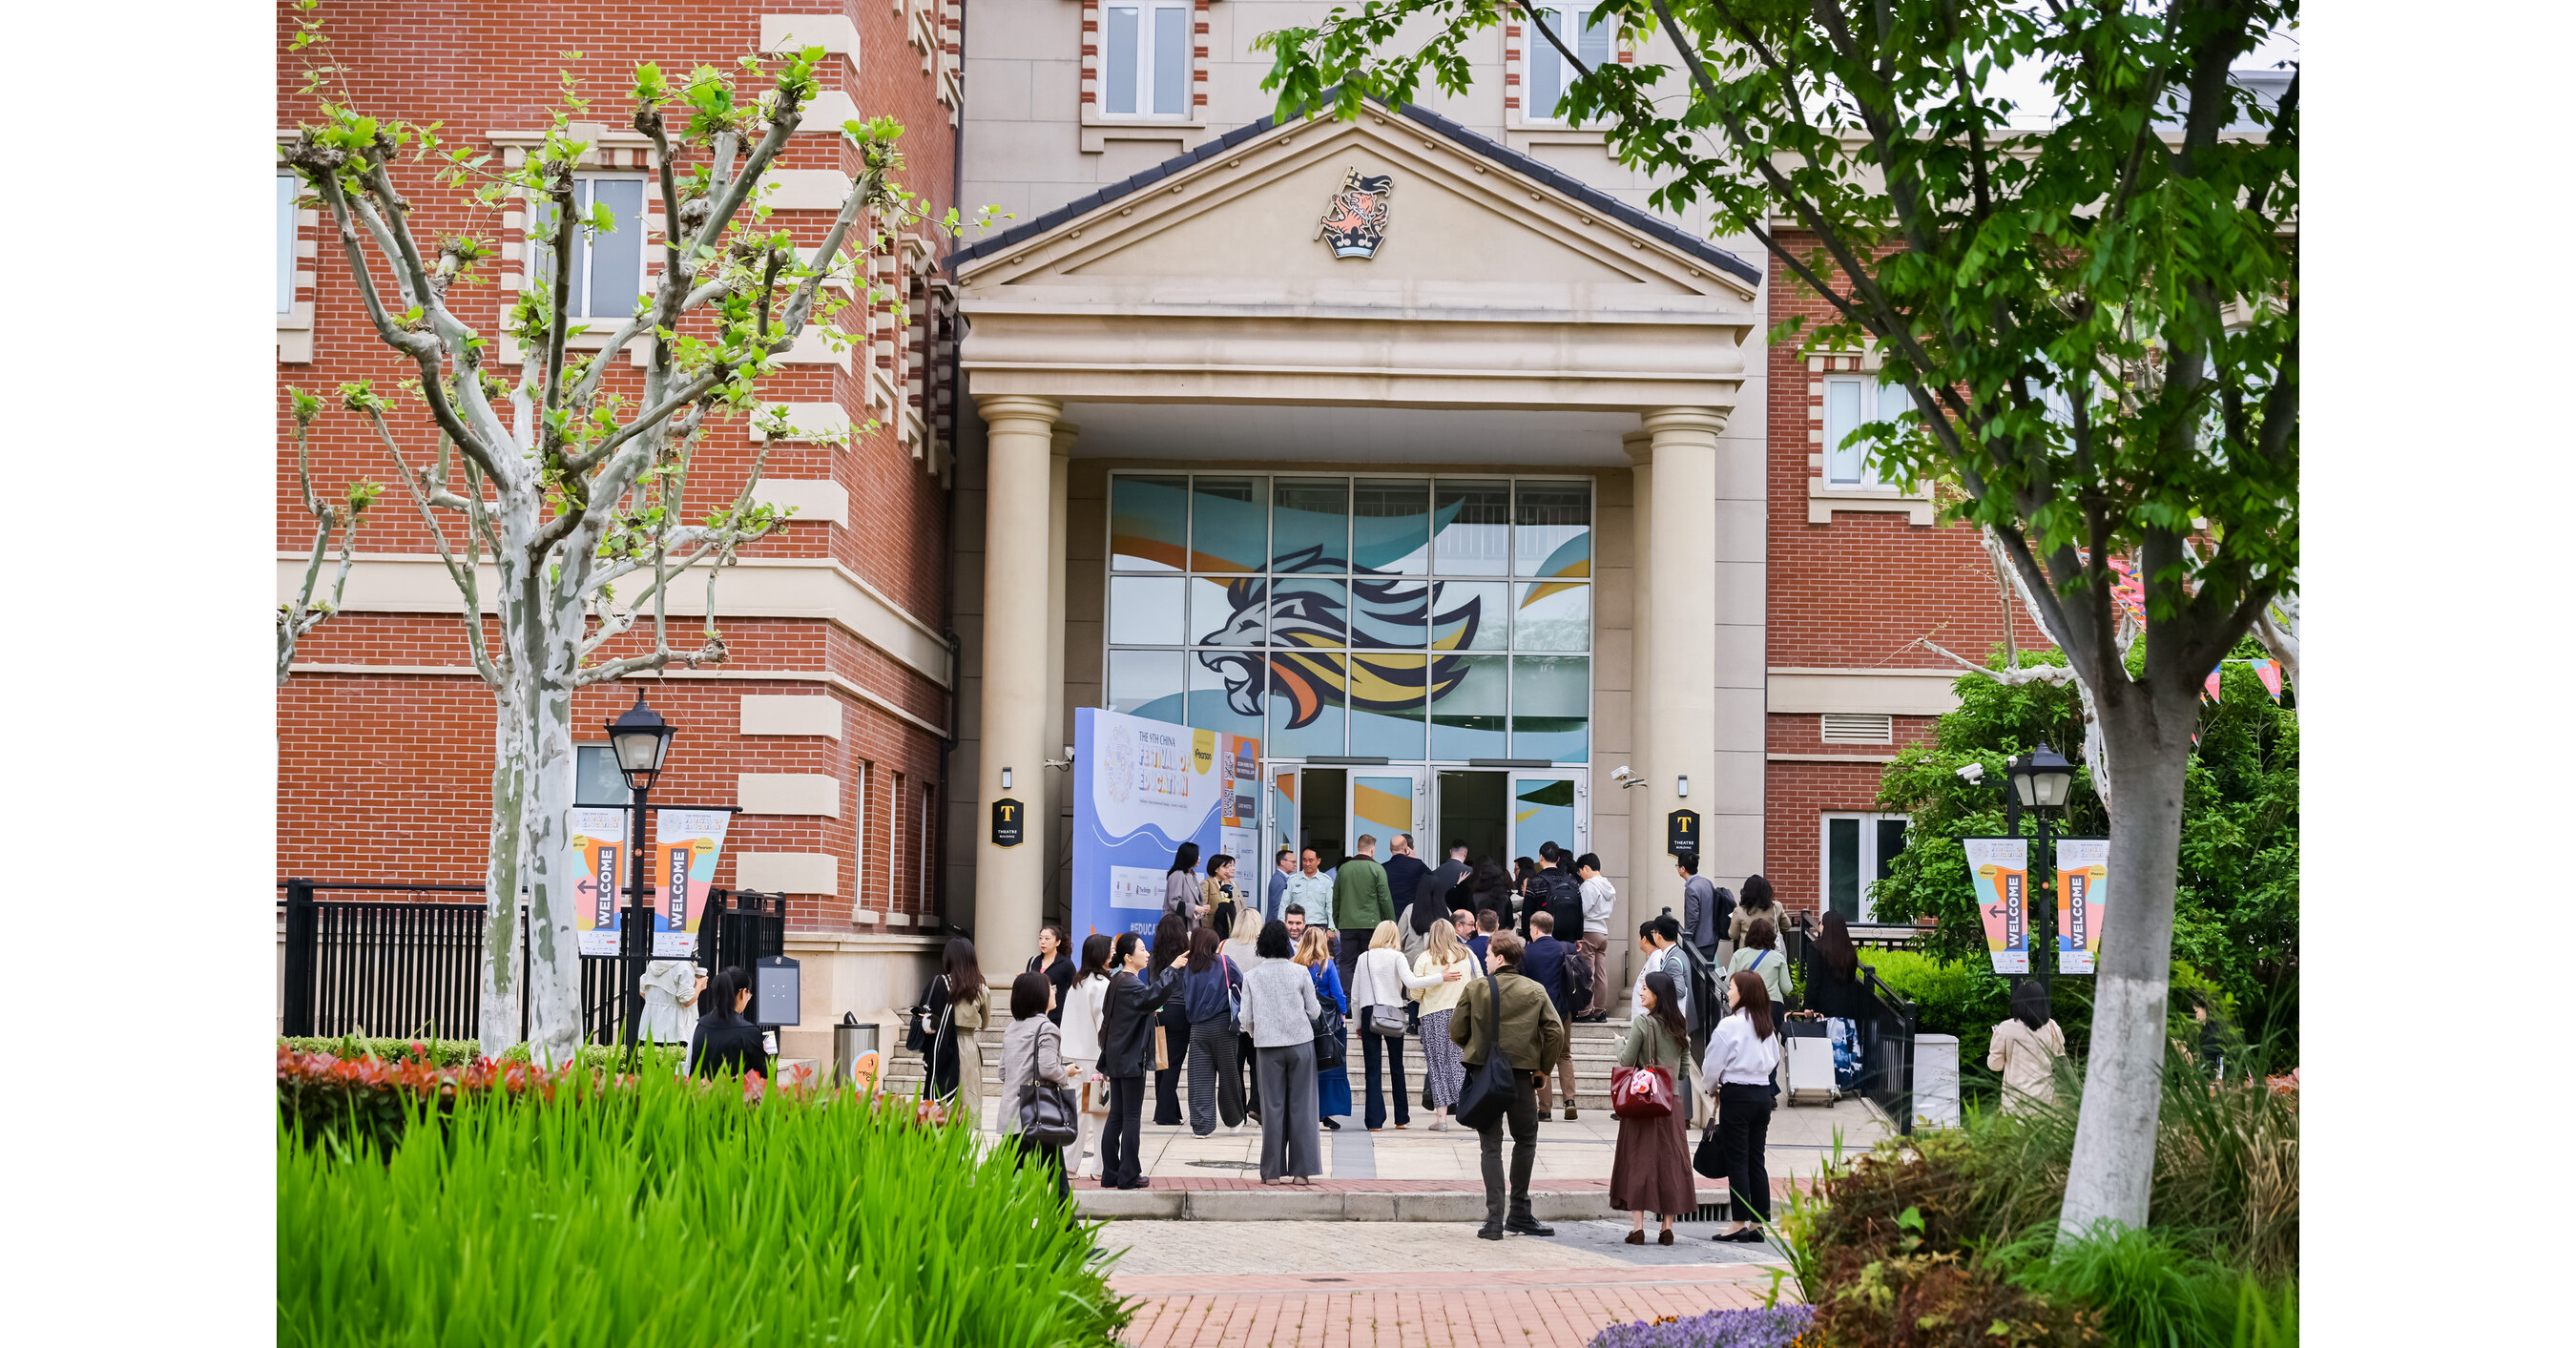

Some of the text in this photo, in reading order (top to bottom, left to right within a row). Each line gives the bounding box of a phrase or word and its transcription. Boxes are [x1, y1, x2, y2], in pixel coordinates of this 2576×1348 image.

[1139, 731, 1175, 747] THE 9TH CHINA
[1180, 750, 1192, 773] OF
[1195, 748, 1212, 760] Pearson
[1139, 770, 1189, 797] EDUCATION
[1001, 806, 1014, 821] T
[1677, 817, 1692, 833] T
[598, 849, 613, 926] WELCOME
[671, 851, 685, 928] WELCOME
[2008, 877, 2020, 947] WELCOME
[2071, 878, 2084, 947] WELCOME
